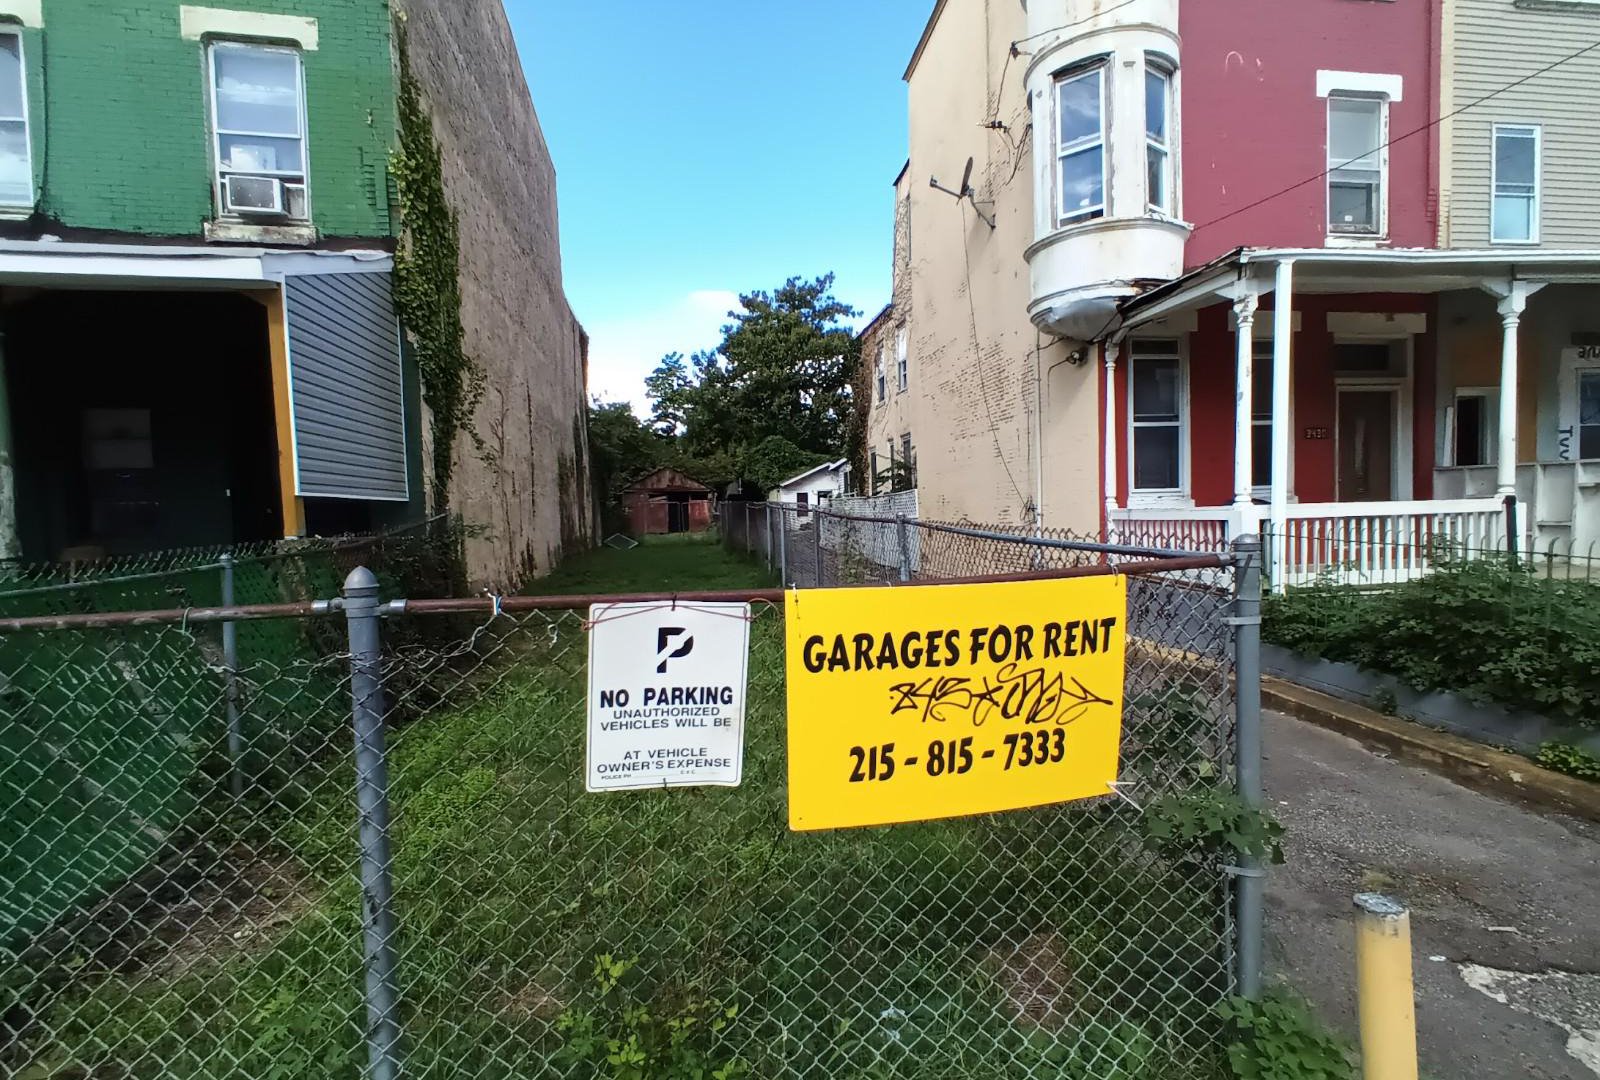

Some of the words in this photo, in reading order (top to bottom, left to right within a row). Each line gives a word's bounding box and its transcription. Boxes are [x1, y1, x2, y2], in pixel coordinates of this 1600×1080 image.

[803, 629, 960, 673] GARAGES
[969, 624, 1034, 665] FOR
[1042, 616, 1117, 658] RENT
[600, 688, 630, 709] NO
[643, 686, 733, 706] PARKING
[613, 706, 720, 720] UNAUTHORIZED
[600, 718, 669, 732] VEHICLES
[675, 718, 708, 728] WILL
[713, 717, 731, 727] BE
[623, 750, 641, 761] AT
[647, 747, 708, 760] VEHICLE
[597, 760, 664, 774] OWNER'S
[667, 758, 731, 769] EXPENSE
